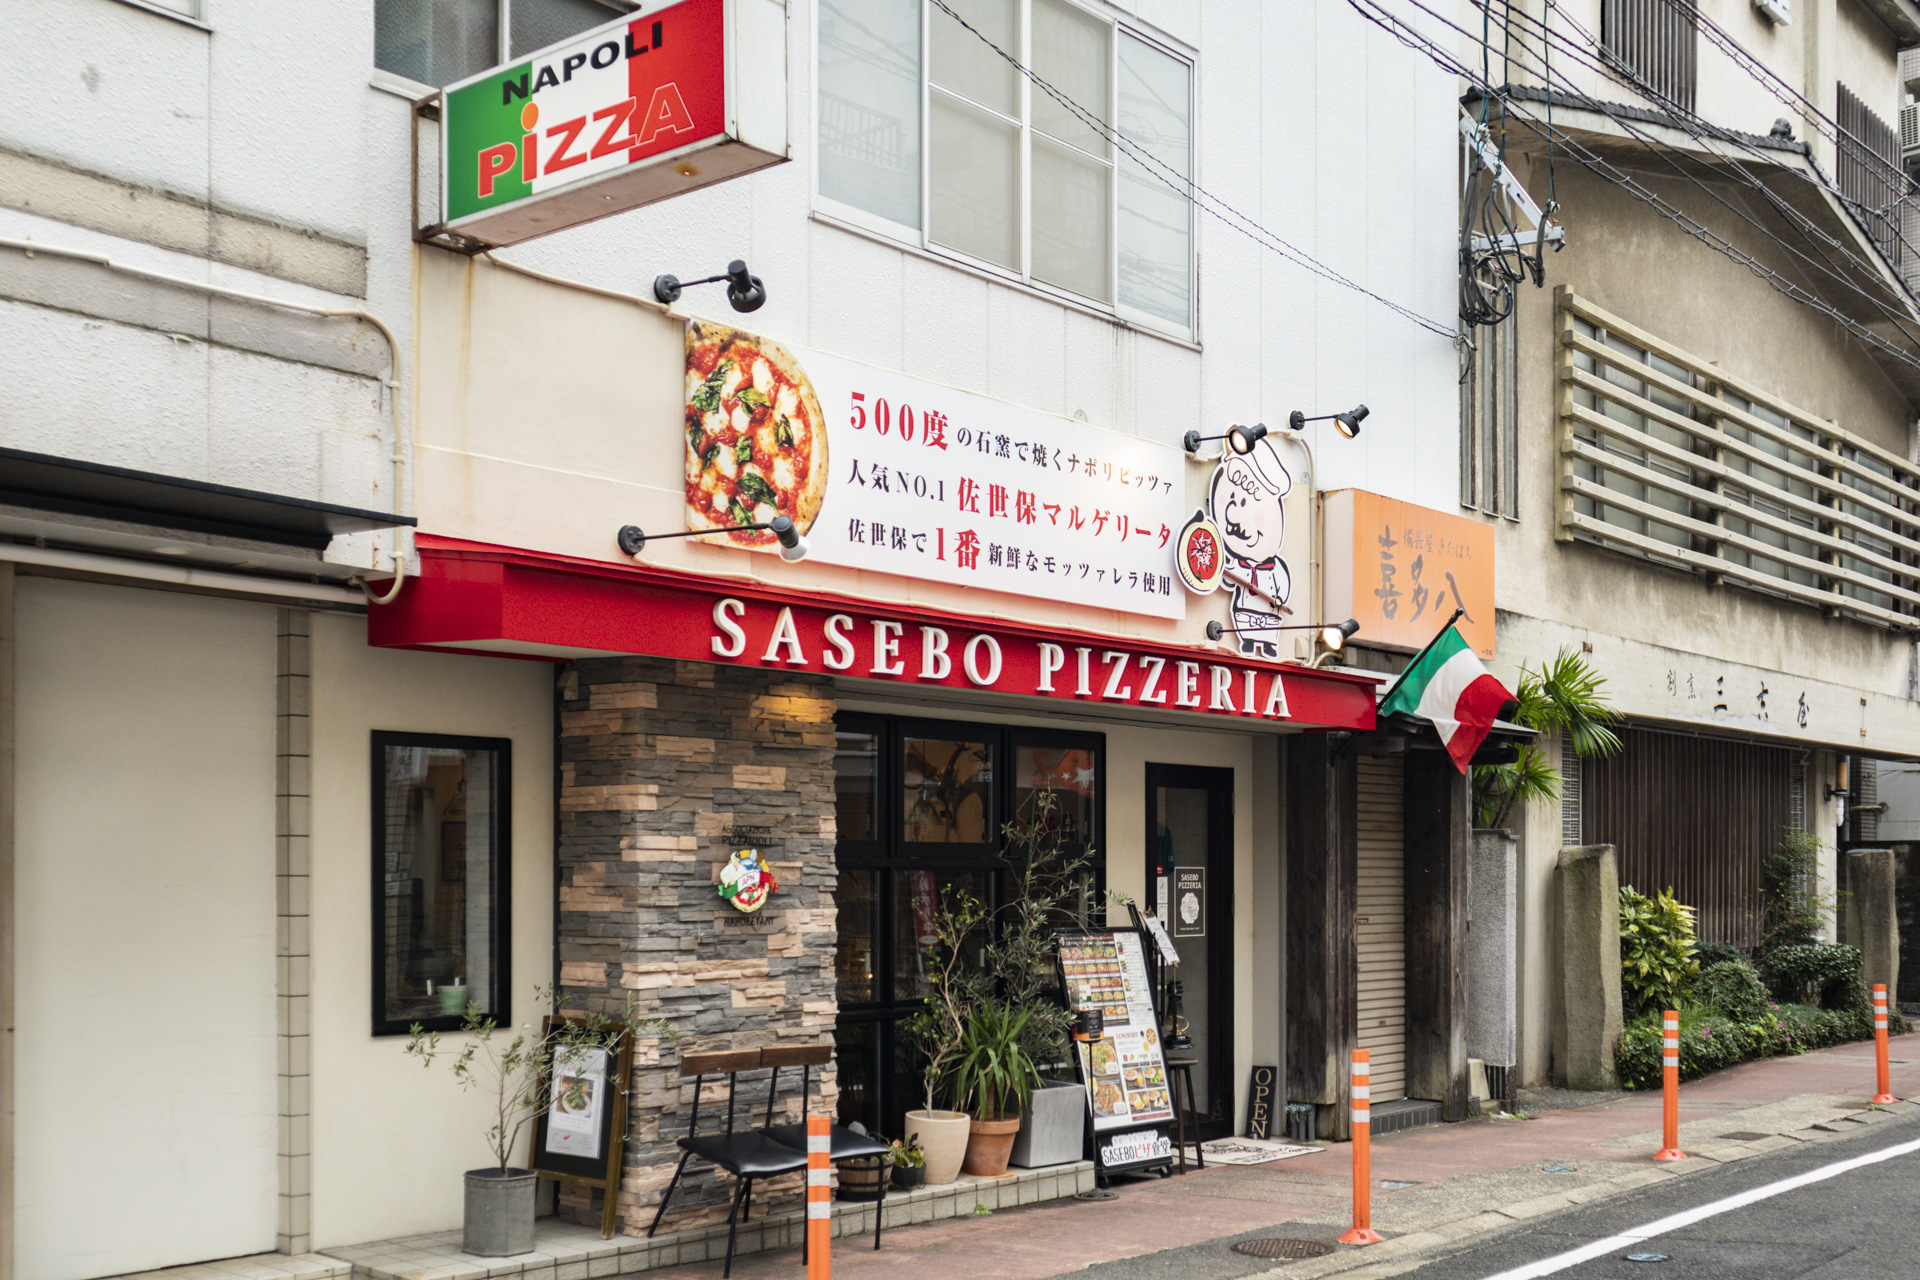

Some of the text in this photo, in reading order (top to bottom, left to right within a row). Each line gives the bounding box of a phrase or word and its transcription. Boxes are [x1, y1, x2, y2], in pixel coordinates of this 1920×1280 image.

[502, 20, 663, 106] NAPOLI
[1374, 524, 1475, 624] 喜多八
[711, 598, 1292, 717] SASEBO PIZZERIA
[742, 874, 755, 887] APN
[1250, 1068, 1272, 1138] OPEN
